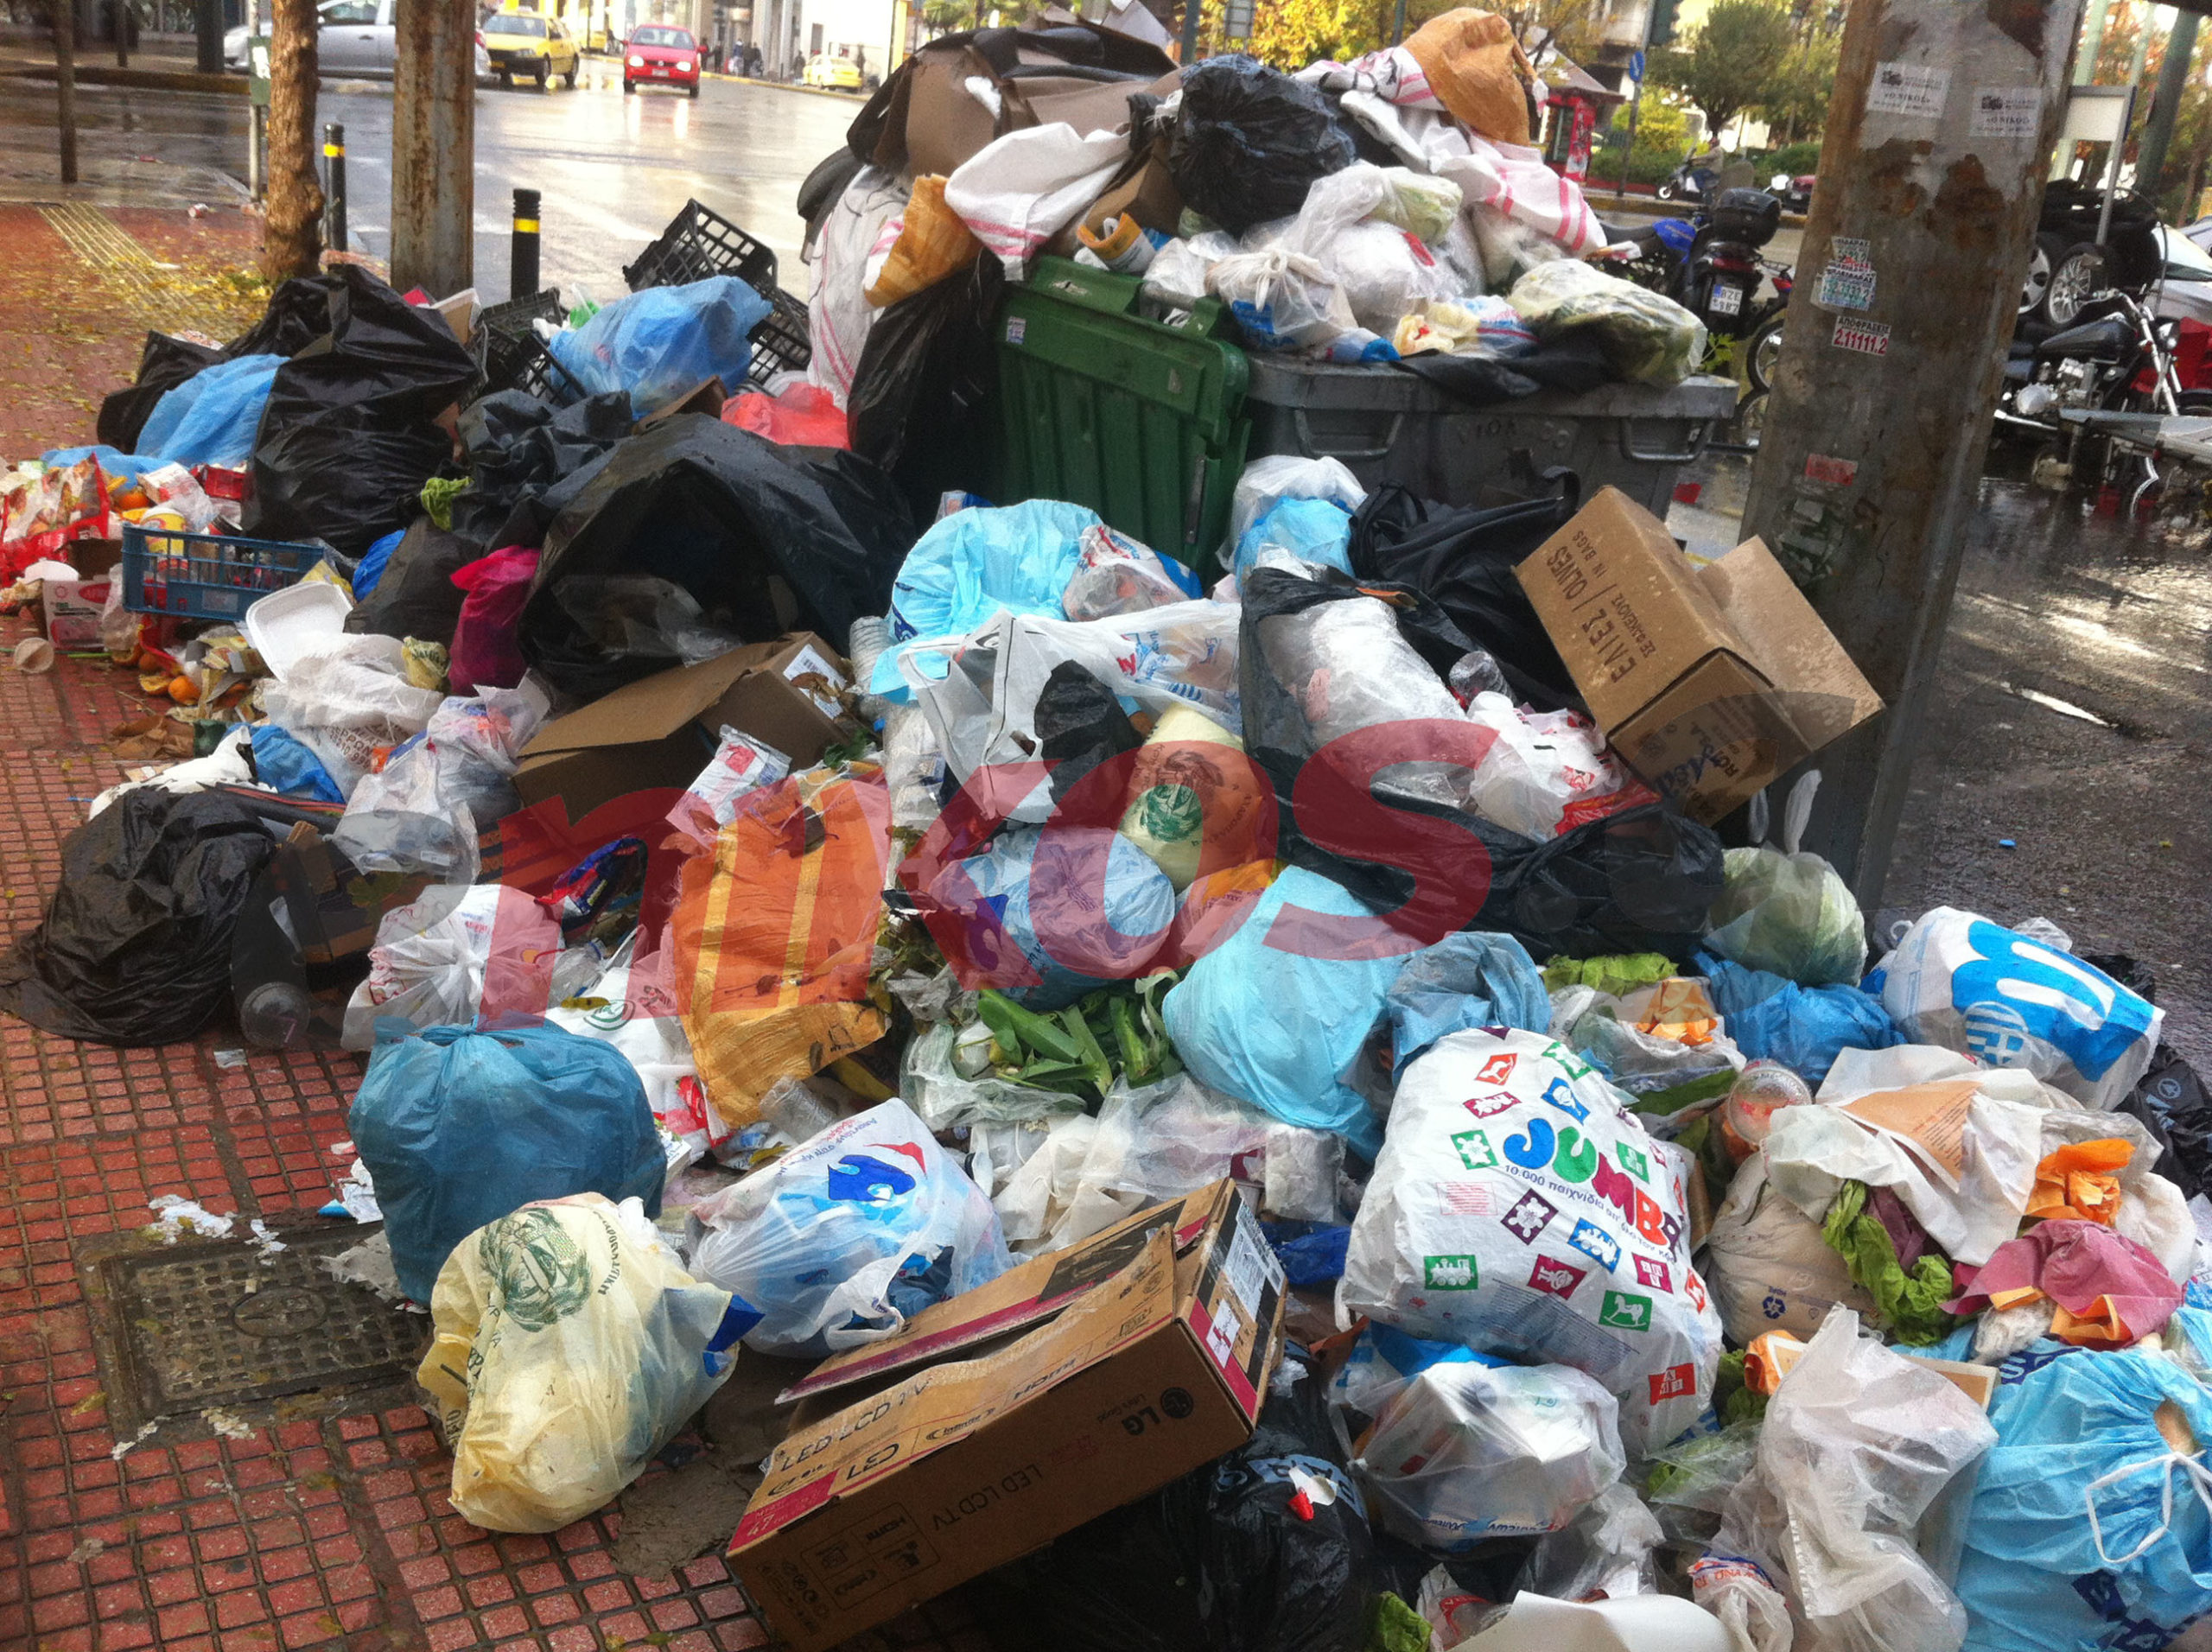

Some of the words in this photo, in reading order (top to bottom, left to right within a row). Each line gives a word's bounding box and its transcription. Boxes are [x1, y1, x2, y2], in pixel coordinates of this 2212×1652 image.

[1573, 531, 1597, 562] BAGS
[1546, 546, 1587, 600] OLIVES
[1582, 607, 1637, 683] ΕΛΙΕΣ
[1503, 1118, 1681, 1262] JUMBO
[1505, 1165, 1545, 1187] 10.000
[1548, 1181, 1605, 1215] παιχνίδια
[780, 1435, 833, 1471] LED
[839, 1402, 891, 1440] LCD
[1122, 1407, 1161, 1436] LG
[846, 1443, 899, 1481] LED
[1001, 1465, 1043, 1493] LED
[931, 1504, 961, 1531] TV
[959, 1486, 1000, 1515] LCD
